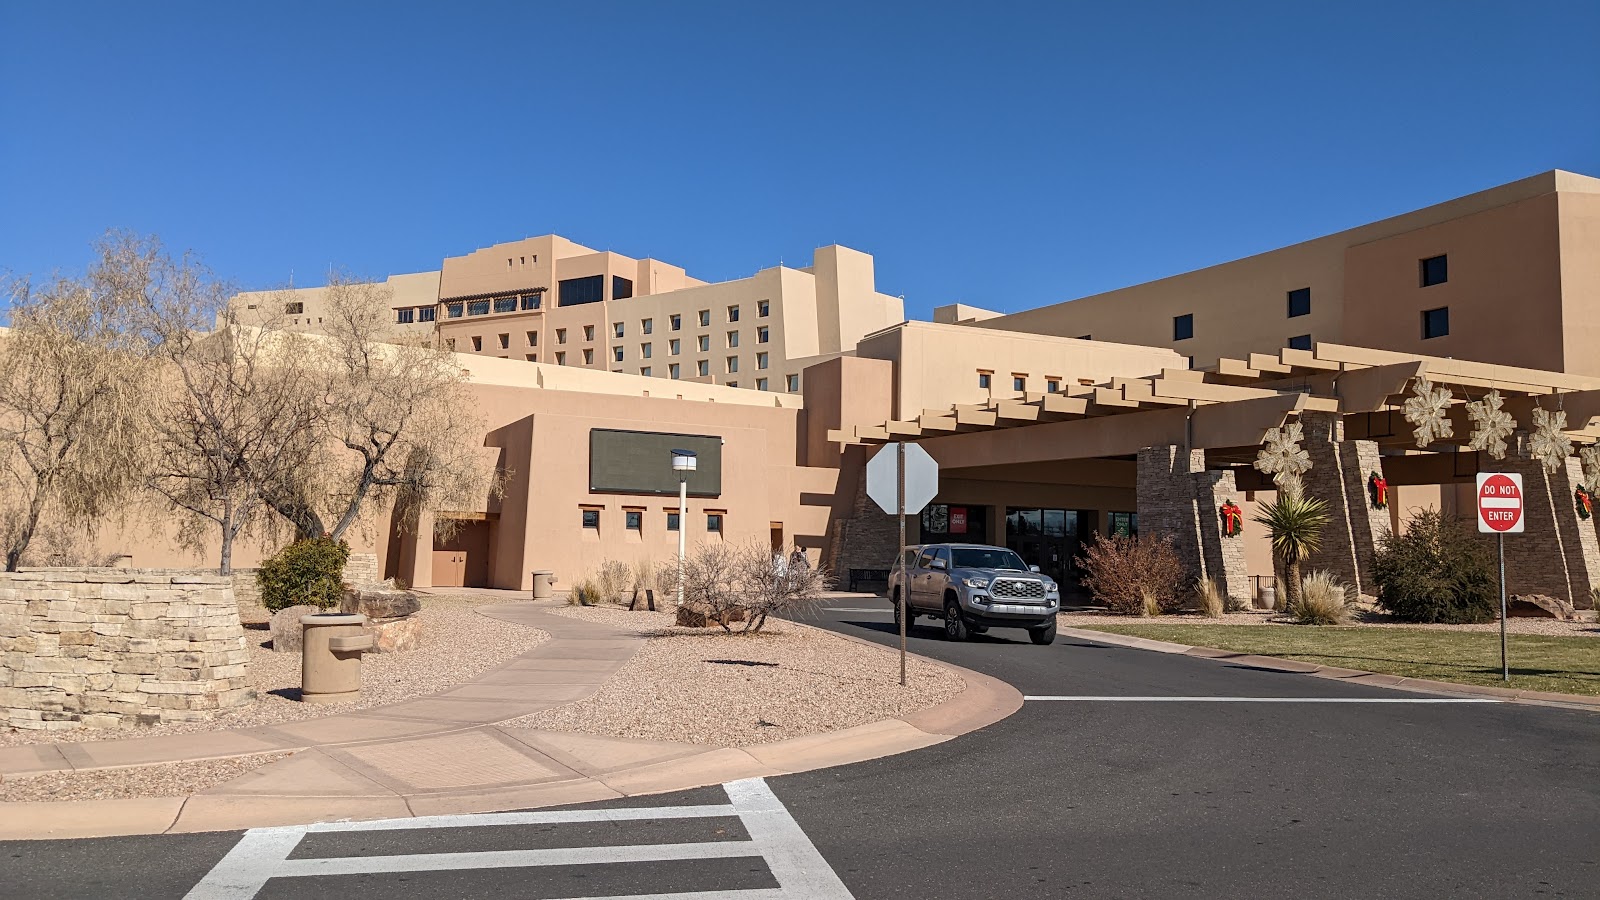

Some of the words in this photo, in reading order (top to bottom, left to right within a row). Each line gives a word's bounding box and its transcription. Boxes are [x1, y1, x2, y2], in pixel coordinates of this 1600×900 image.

[1484, 485, 1496, 495] DO
[1499, 485, 1516, 495] NOT
[1488, 511, 1514, 521] ENTER
